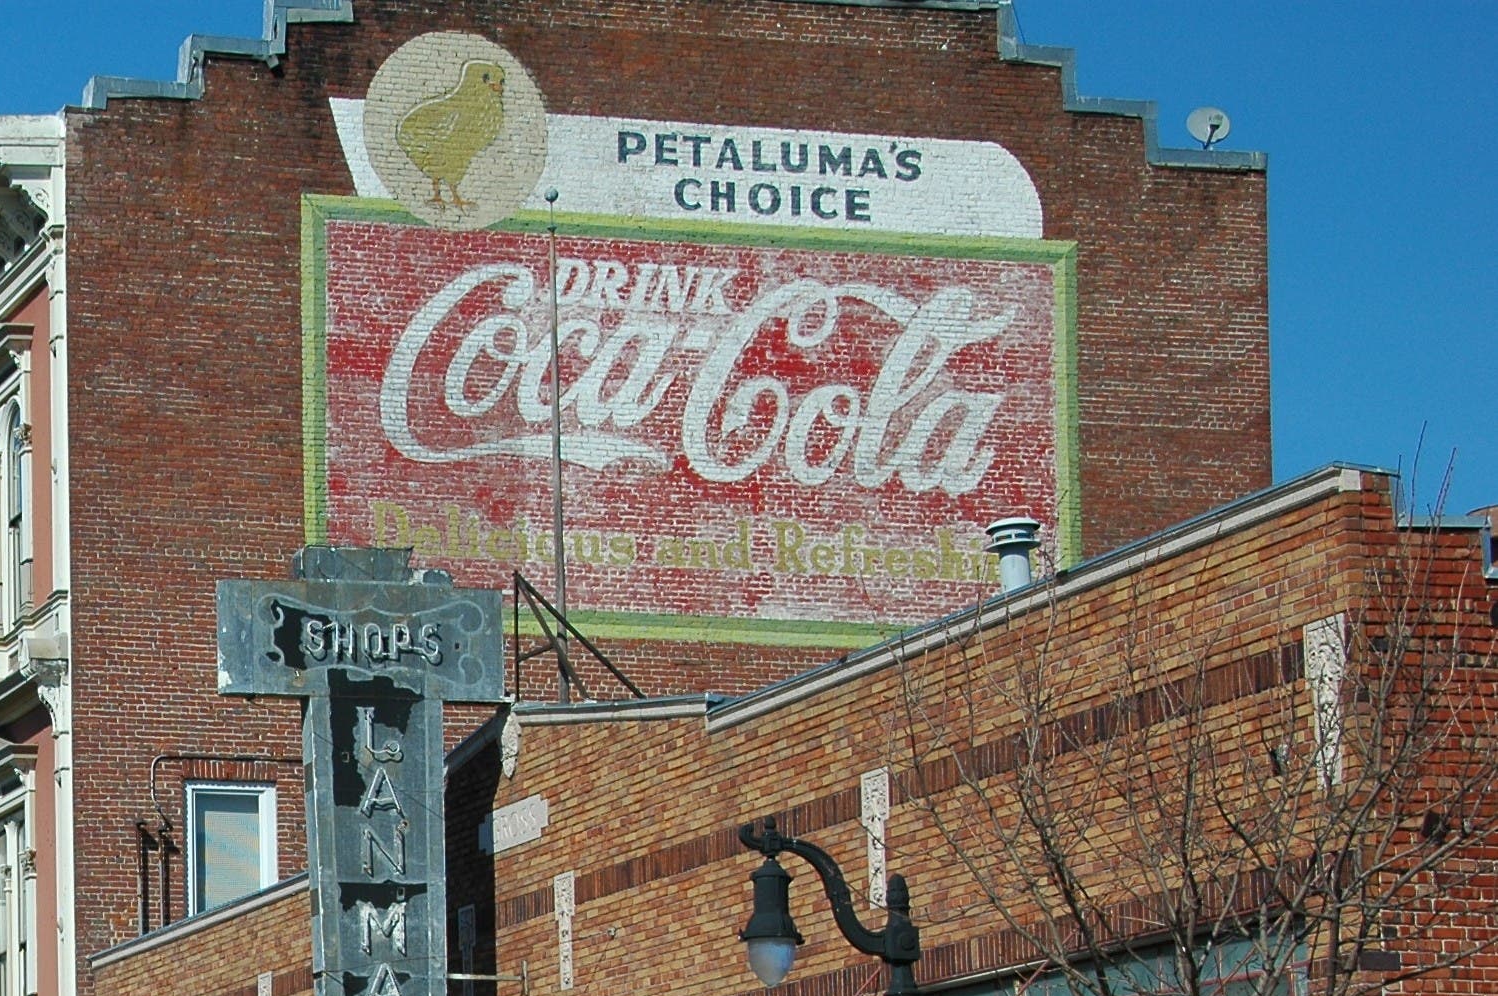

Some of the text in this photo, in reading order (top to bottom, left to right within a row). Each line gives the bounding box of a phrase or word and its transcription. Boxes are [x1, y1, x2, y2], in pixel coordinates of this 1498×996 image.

[616, 130, 923, 182] PETALUMA'S
[674, 177, 872, 222] CHOICE
[552, 258, 740, 316] DRINK
[373, 501, 637, 567] Delicious
[655, 519, 752, 571] and
[305, 619, 442, 663] SHOPS
